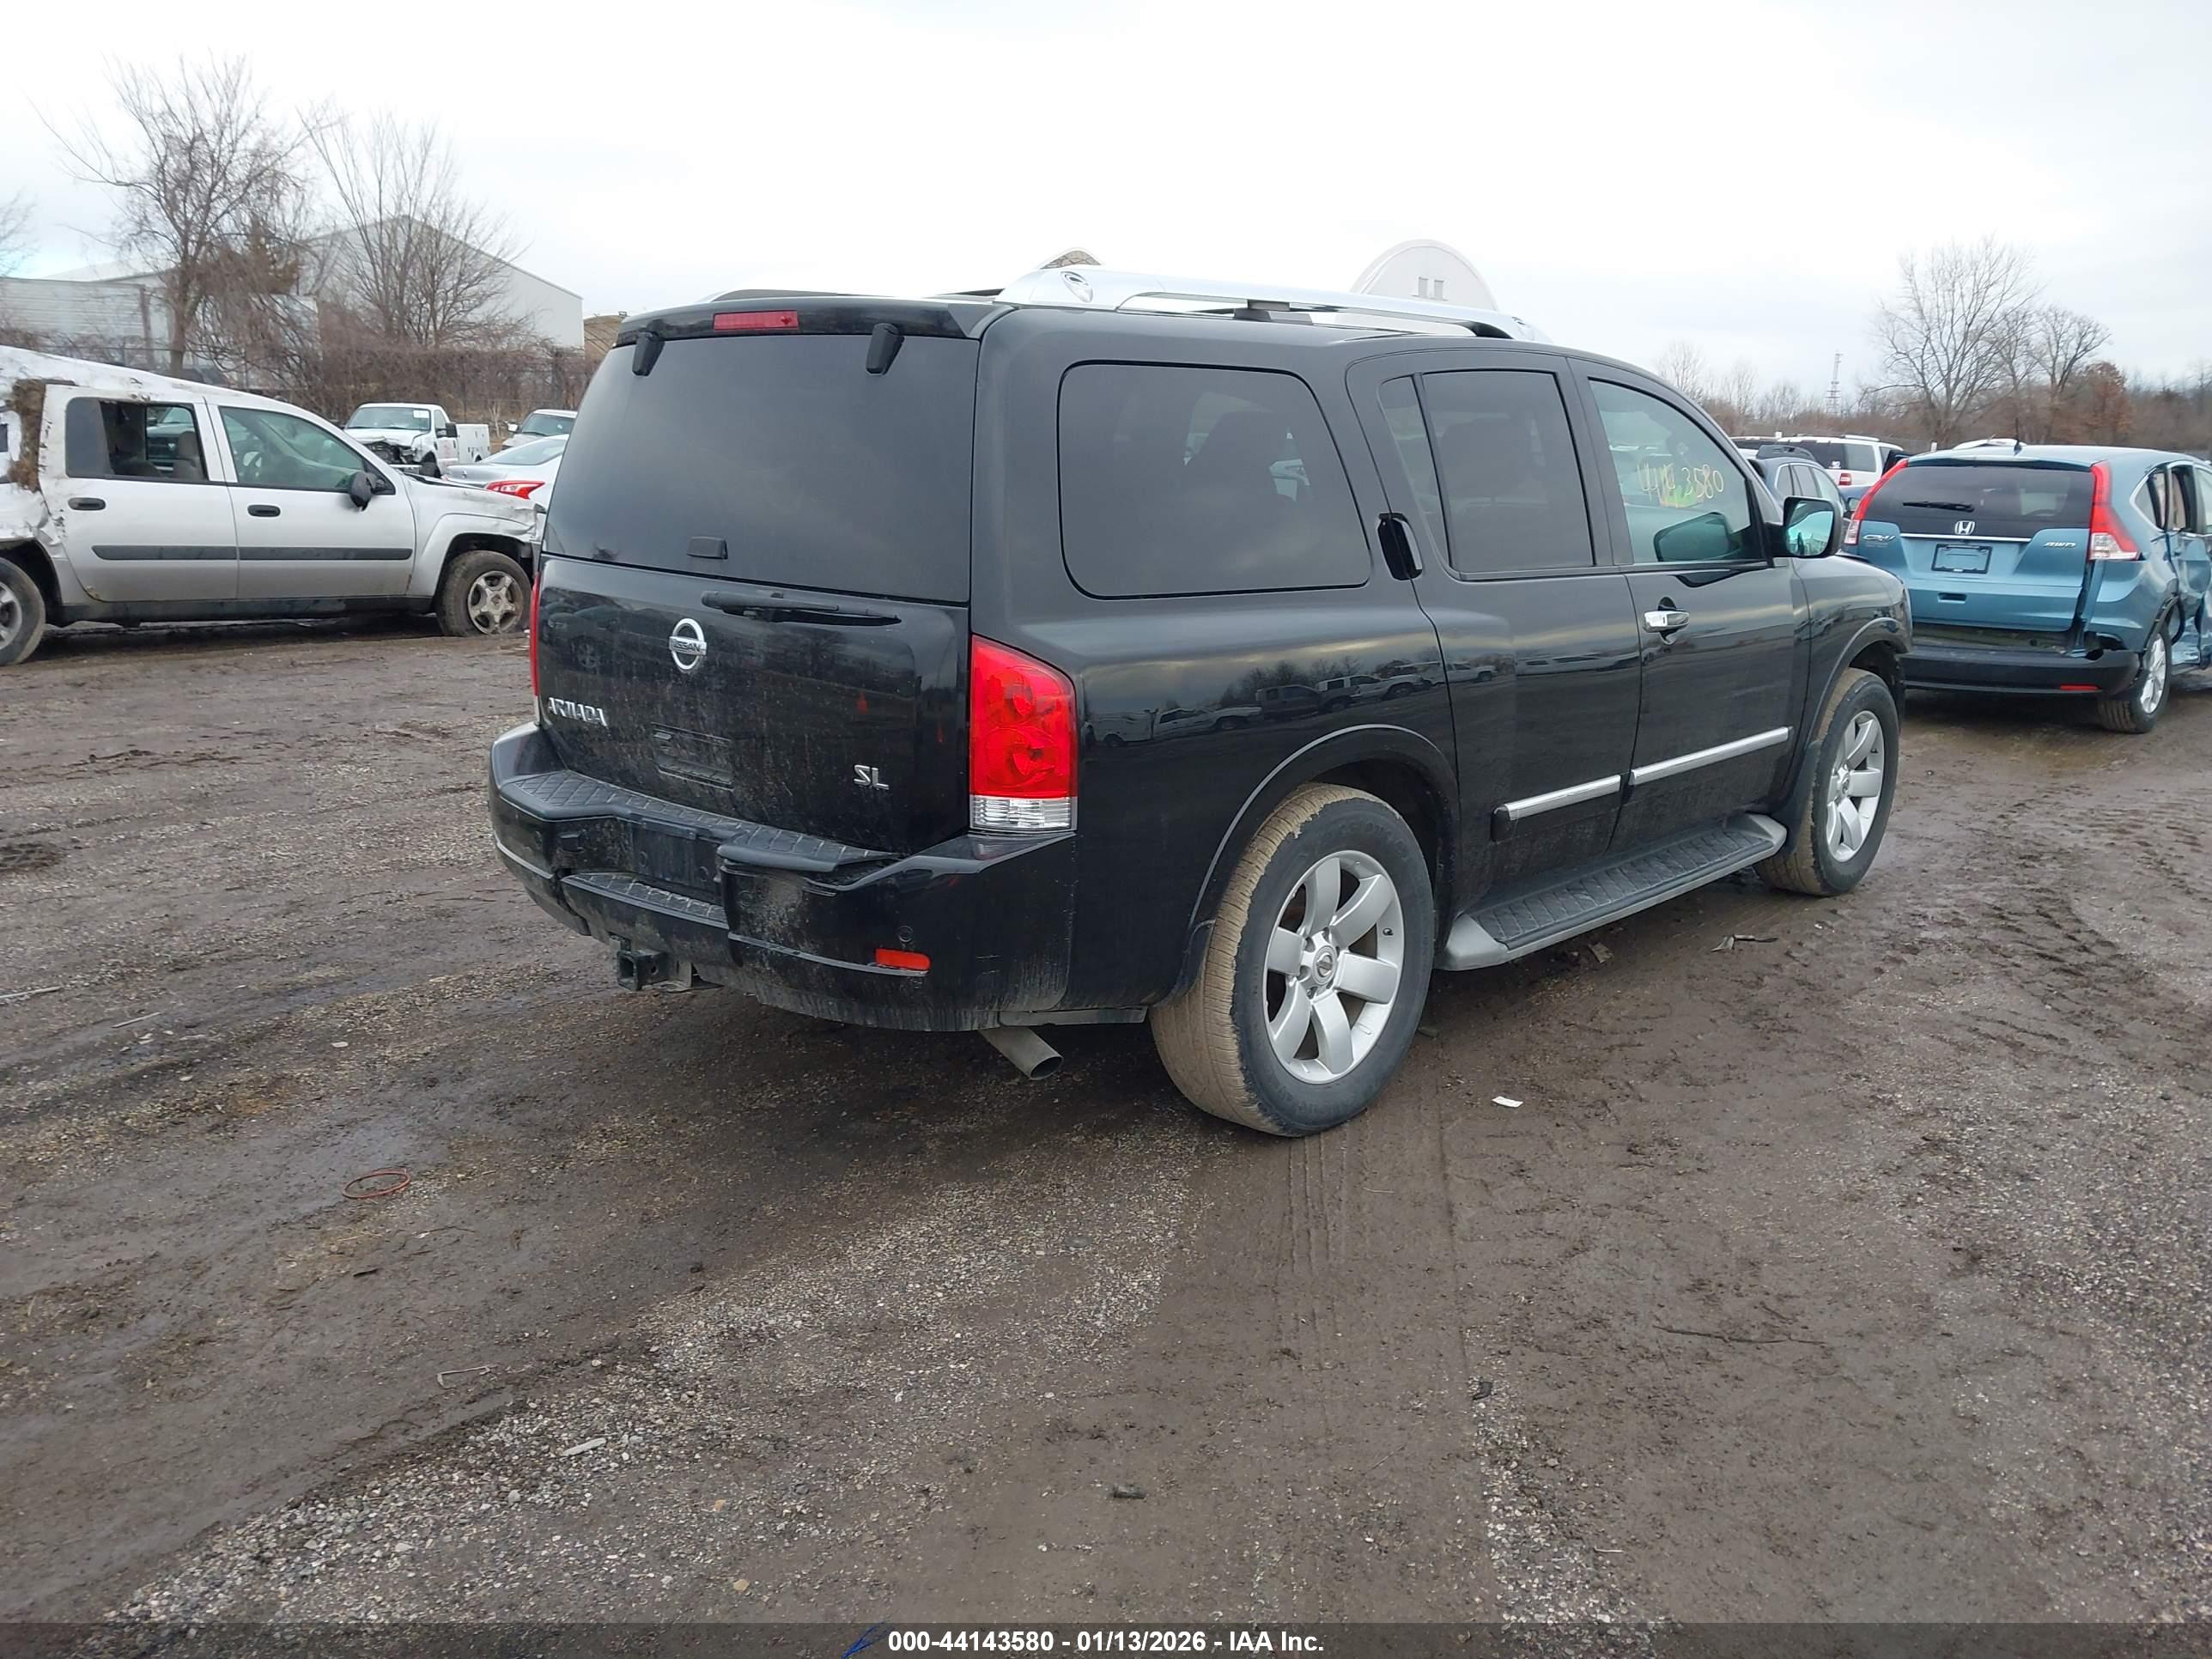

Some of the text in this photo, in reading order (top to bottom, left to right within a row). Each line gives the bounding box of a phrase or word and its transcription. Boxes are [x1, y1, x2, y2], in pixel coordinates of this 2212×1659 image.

[1681, 464, 1724, 499] 3580
[548, 696, 608, 727] ARMADA
[854, 764, 890, 790] SL
